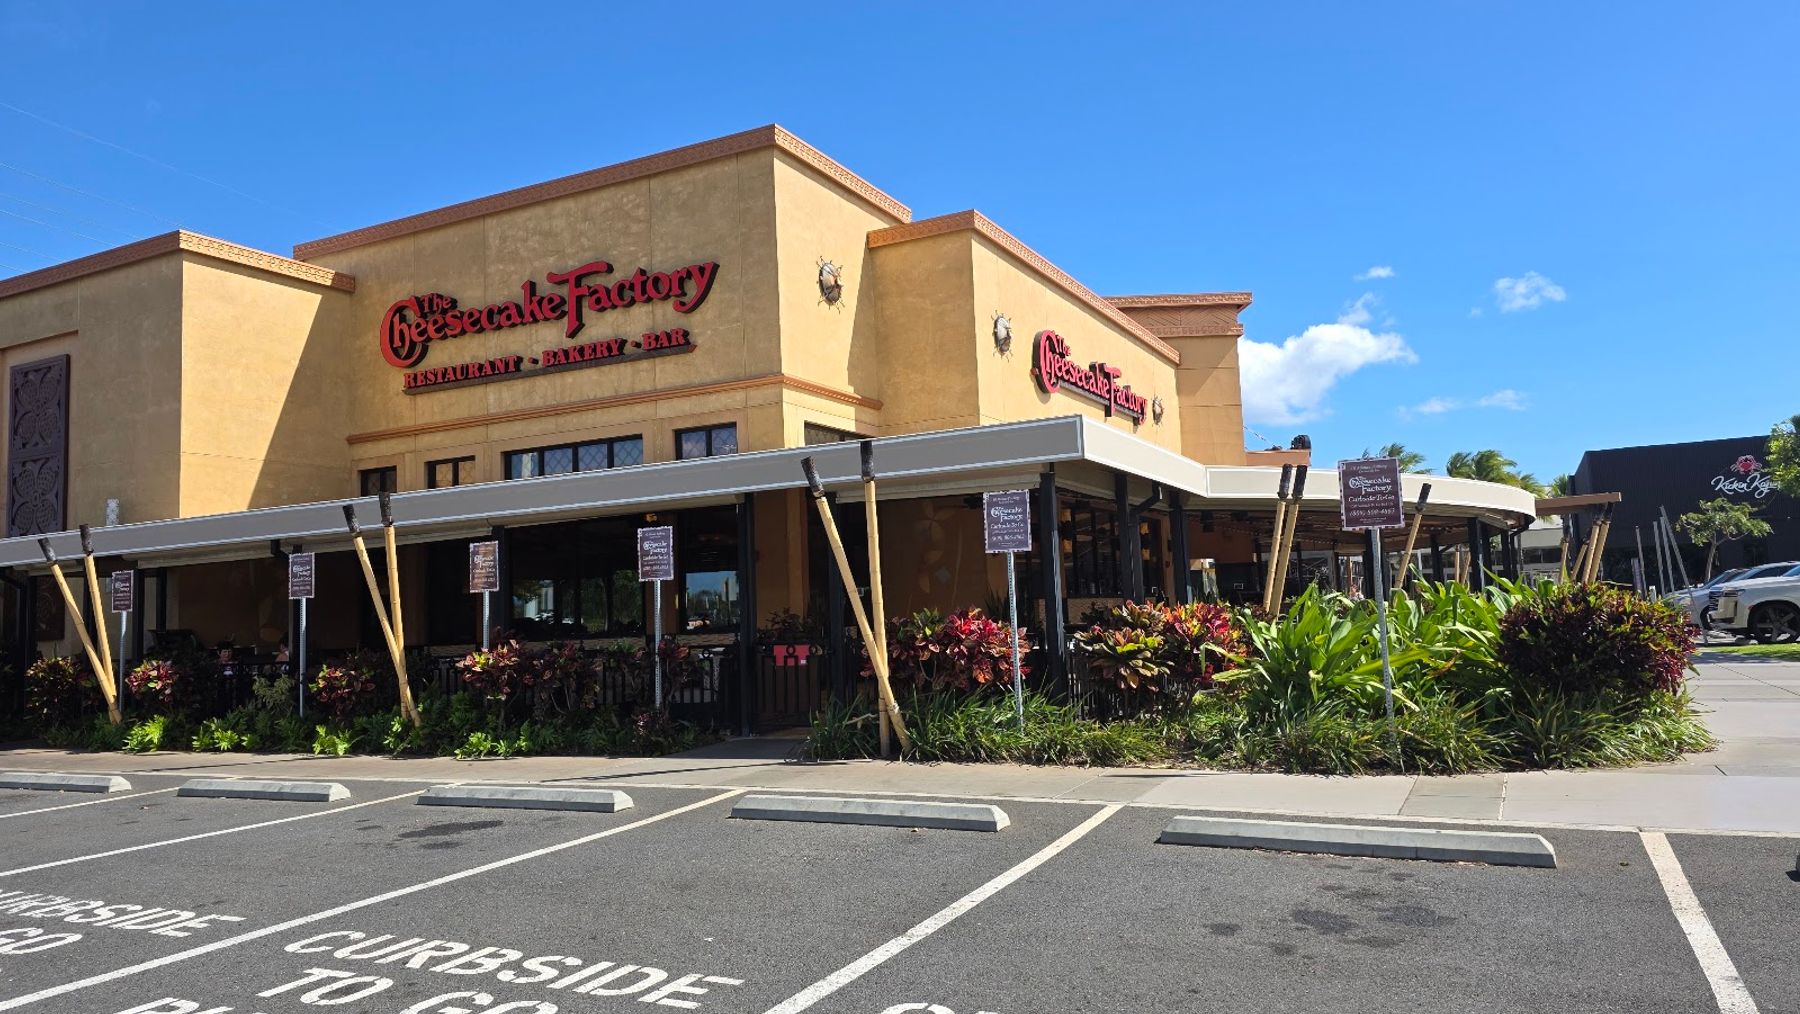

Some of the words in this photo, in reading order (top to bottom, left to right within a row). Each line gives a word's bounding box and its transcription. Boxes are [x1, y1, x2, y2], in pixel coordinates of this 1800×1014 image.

[380, 279, 569, 368] Cheesecake
[546, 260, 720, 339] Factory
[421, 292, 457, 316] The
[402, 355, 523, 389] RESTAURANT
[541, 337, 628, 367] BAKERY
[641, 328, 691, 350] BAR
[1055, 334, 1071, 357] The
[1035, 329, 1110, 400] Cheesecake
[1104, 364, 1148, 426] Factory
[1711, 475, 1752, 495] Kickin
[255, 967, 394, 1006] TO
[284, 929, 746, 1011] CURBSIDE
